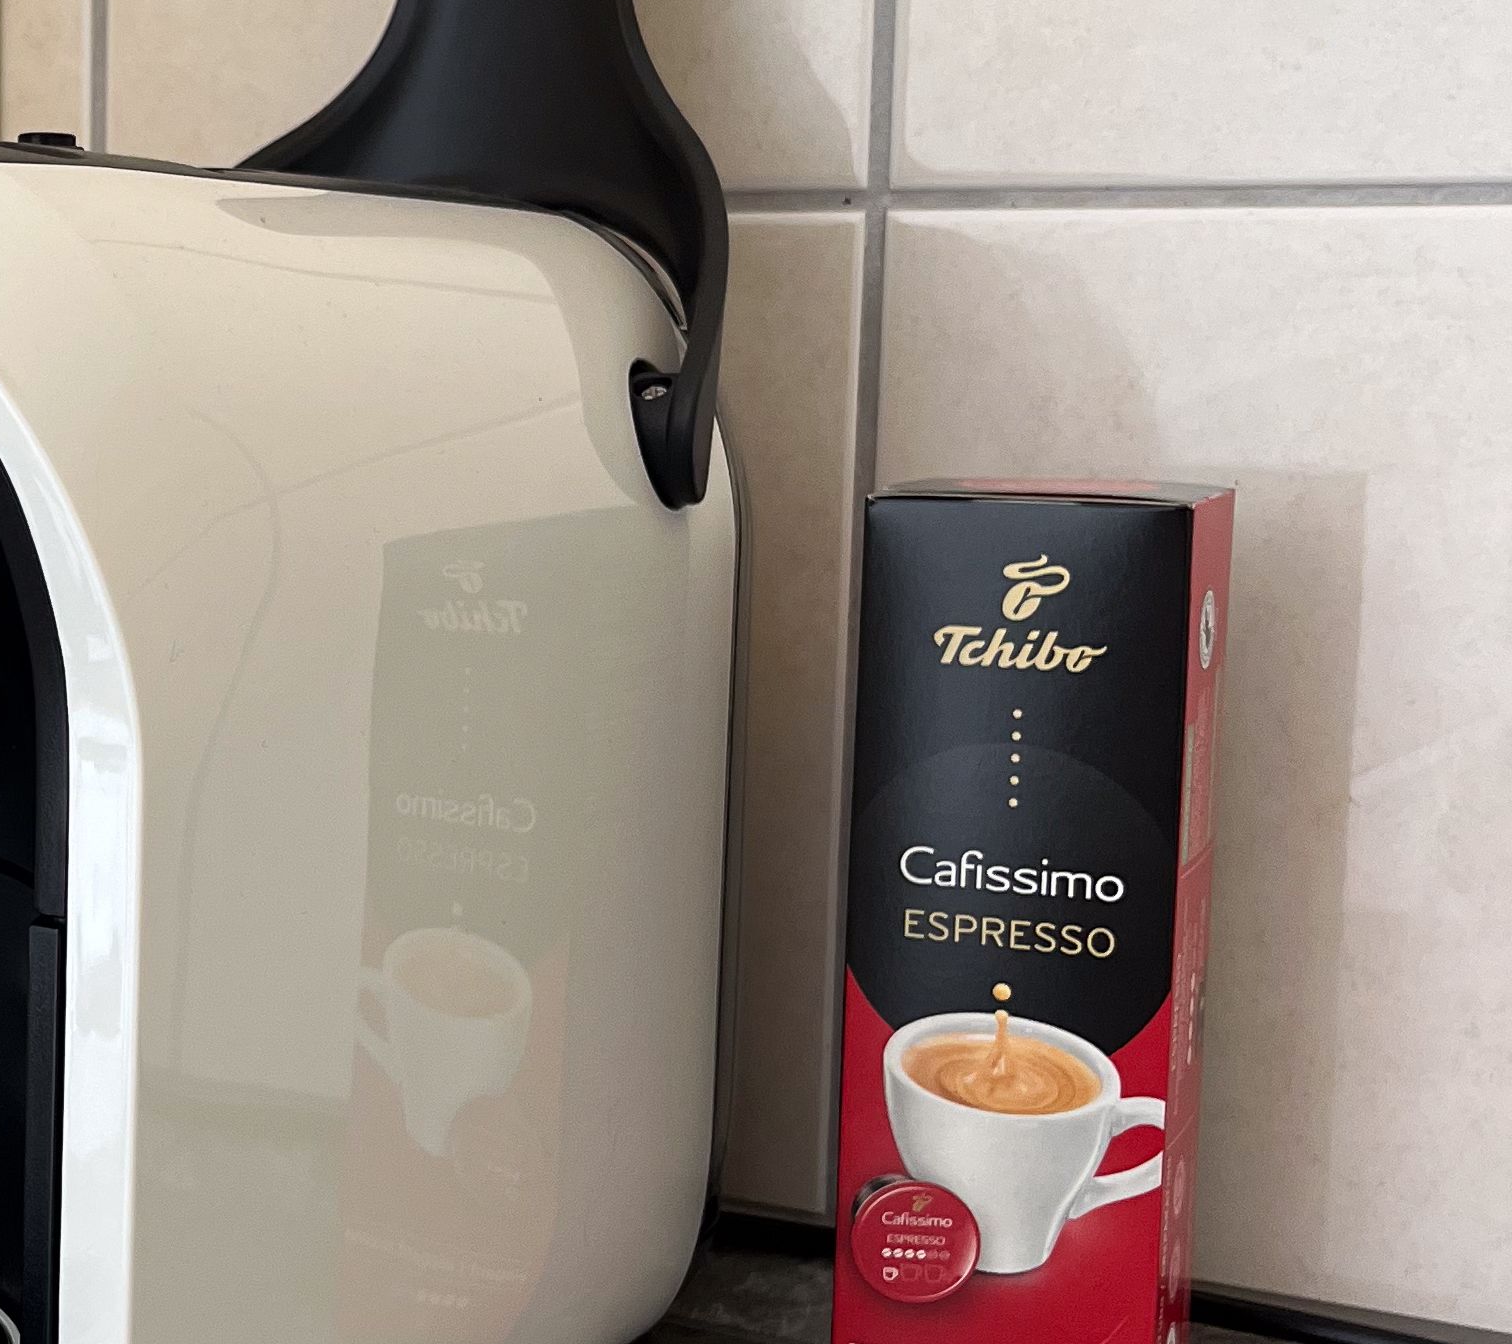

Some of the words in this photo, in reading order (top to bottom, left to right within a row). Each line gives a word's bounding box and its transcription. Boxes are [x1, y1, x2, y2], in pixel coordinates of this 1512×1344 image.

[934, 624, 1107, 673] Tchibo
[899, 846, 1124, 903] Cafissimo
[904, 909, 1116, 958] ESPRESSO
[881, 1211, 953, 1228] Cafissimo
